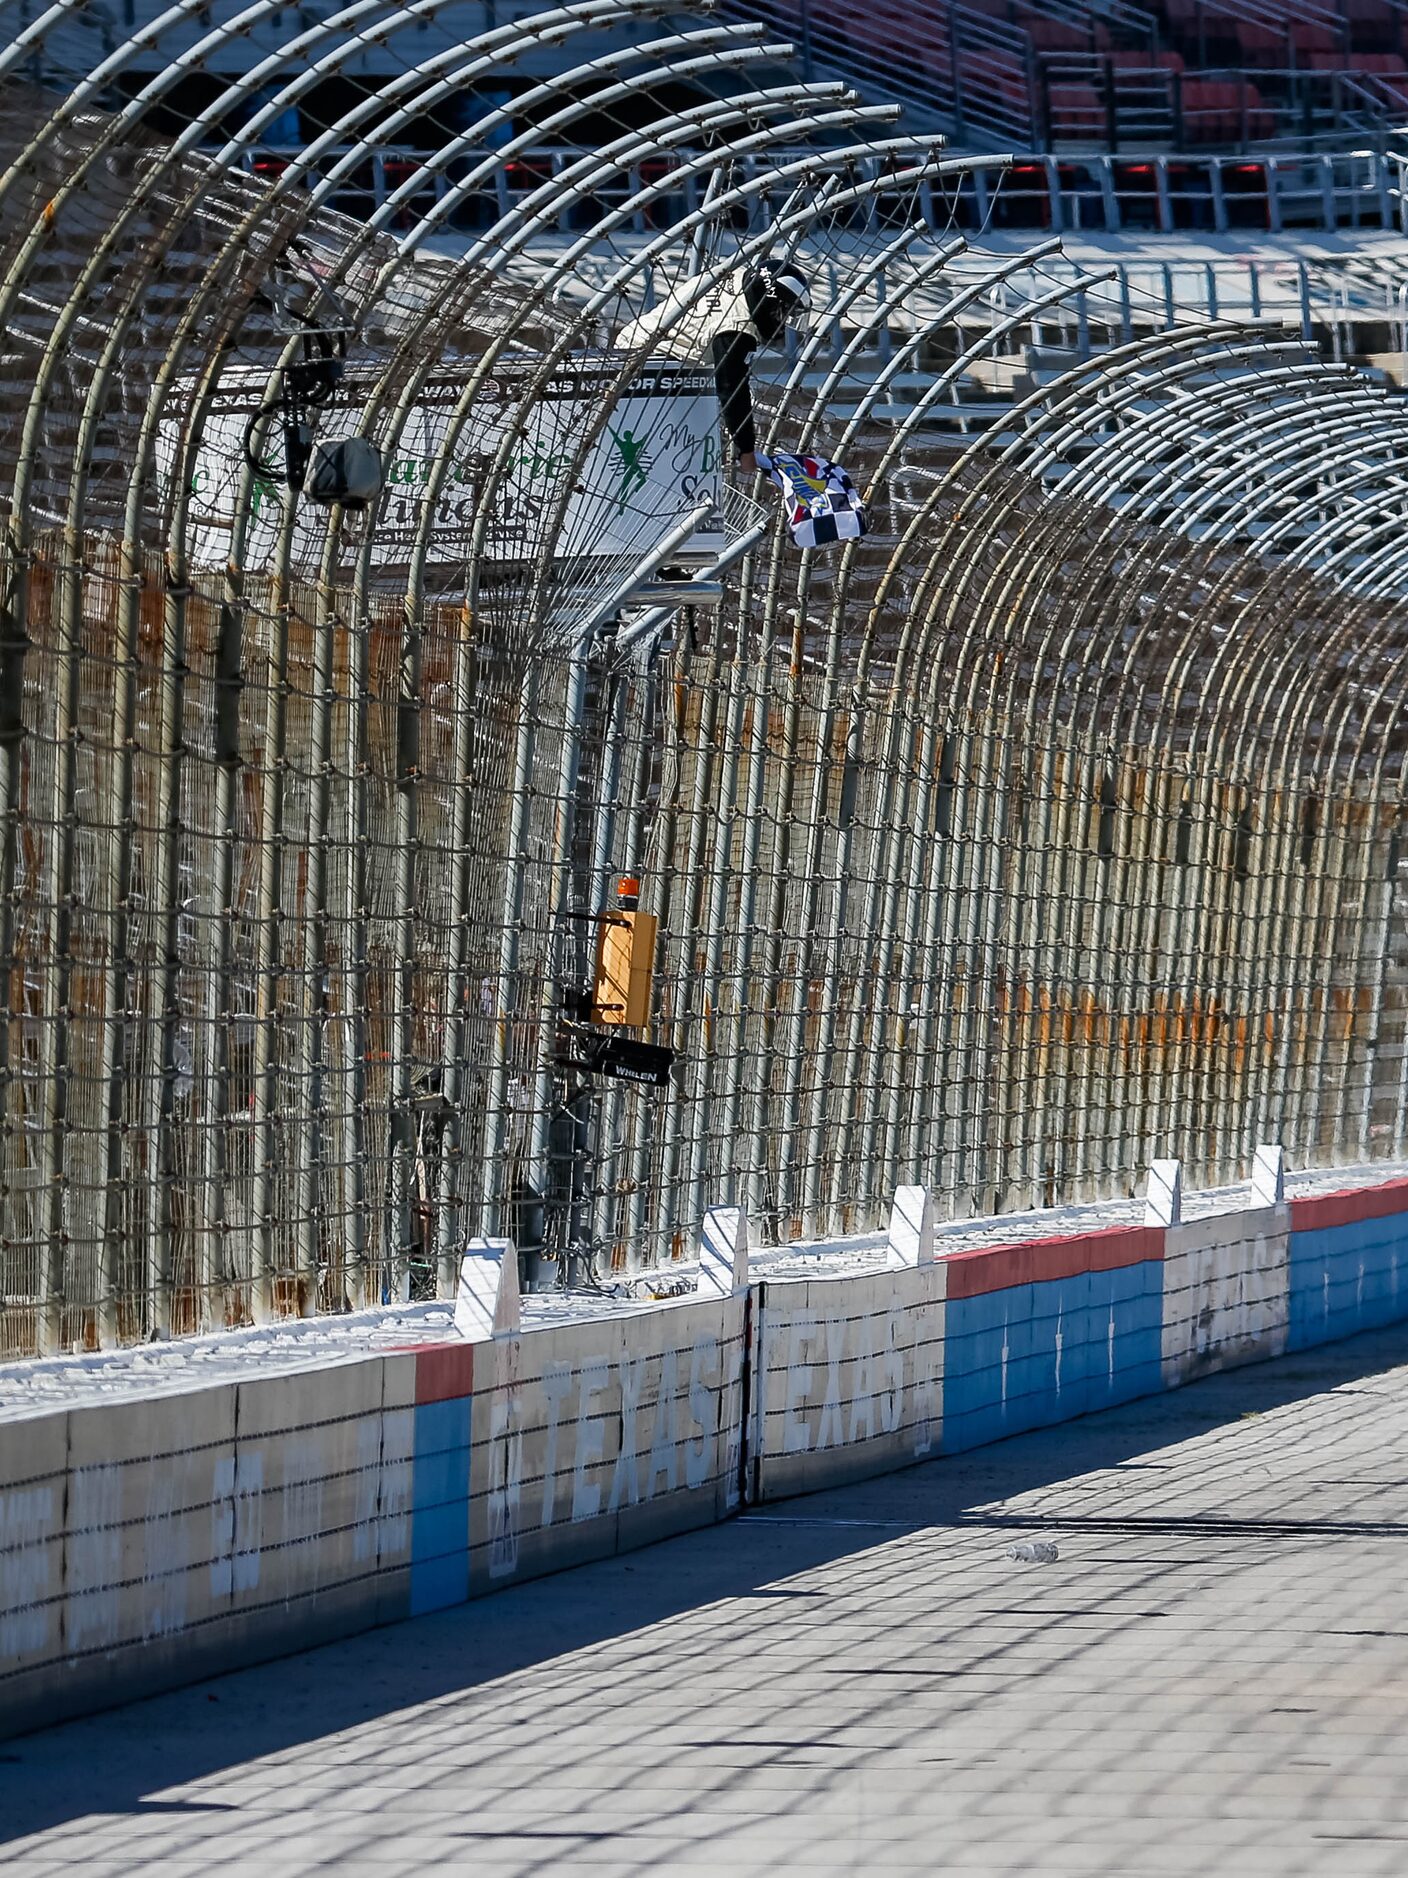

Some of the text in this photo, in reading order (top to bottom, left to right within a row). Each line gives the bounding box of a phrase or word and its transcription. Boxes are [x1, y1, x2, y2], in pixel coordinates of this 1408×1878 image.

[580, 379, 656, 392] MOOR
[210, 392, 263, 408] EXAS
[615, 1064, 658, 1082] WHELEN
